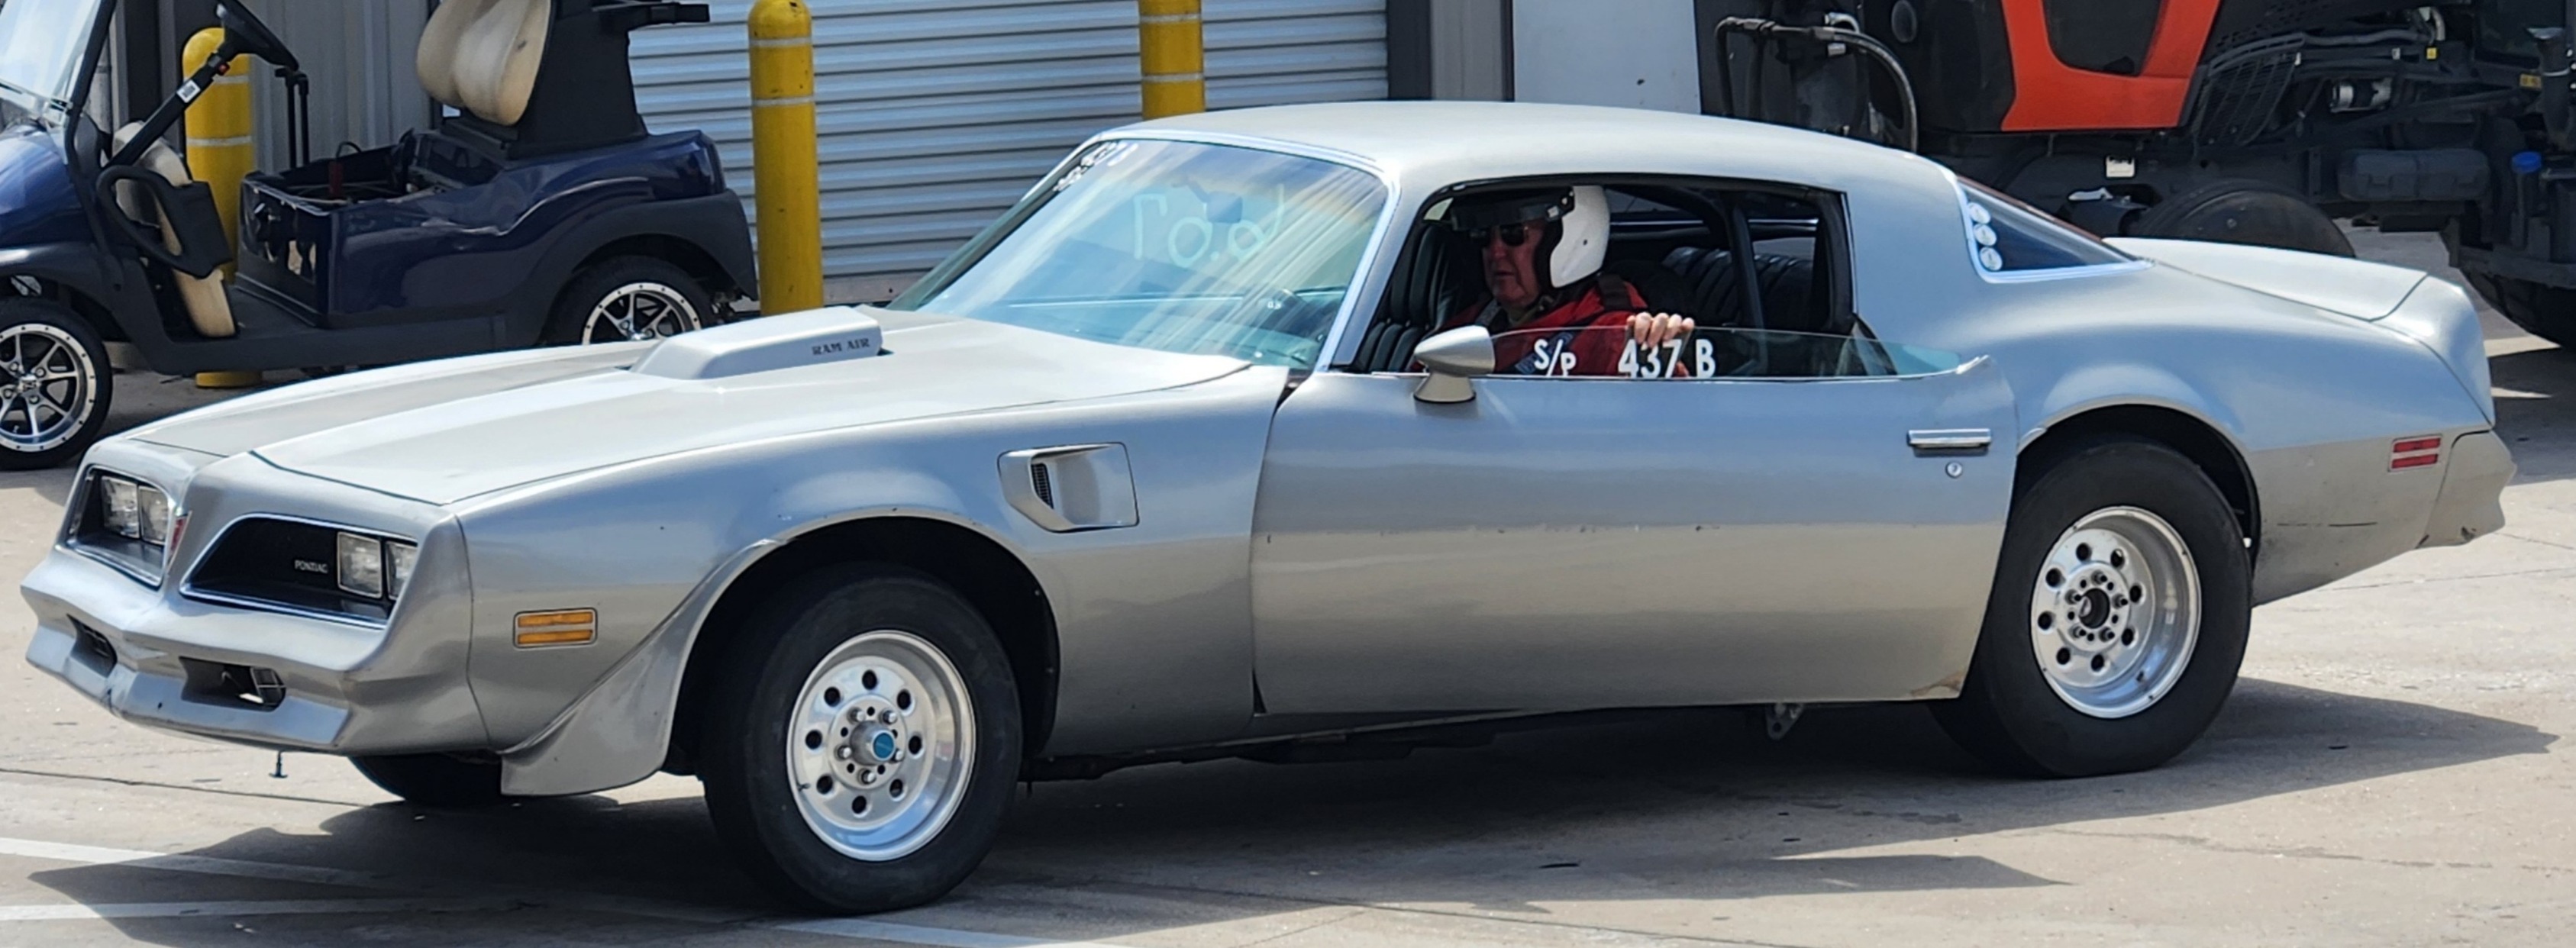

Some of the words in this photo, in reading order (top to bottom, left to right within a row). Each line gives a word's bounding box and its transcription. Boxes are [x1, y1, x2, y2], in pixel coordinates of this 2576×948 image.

[812, 342, 843, 355] RAM
[847, 338, 870, 350] AIR
[1533, 339, 1577, 377] S/P
[1617, 339, 1681, 379] 437
[1695, 339, 1716, 379] B
[294, 559, 328, 573] PONTIAC
